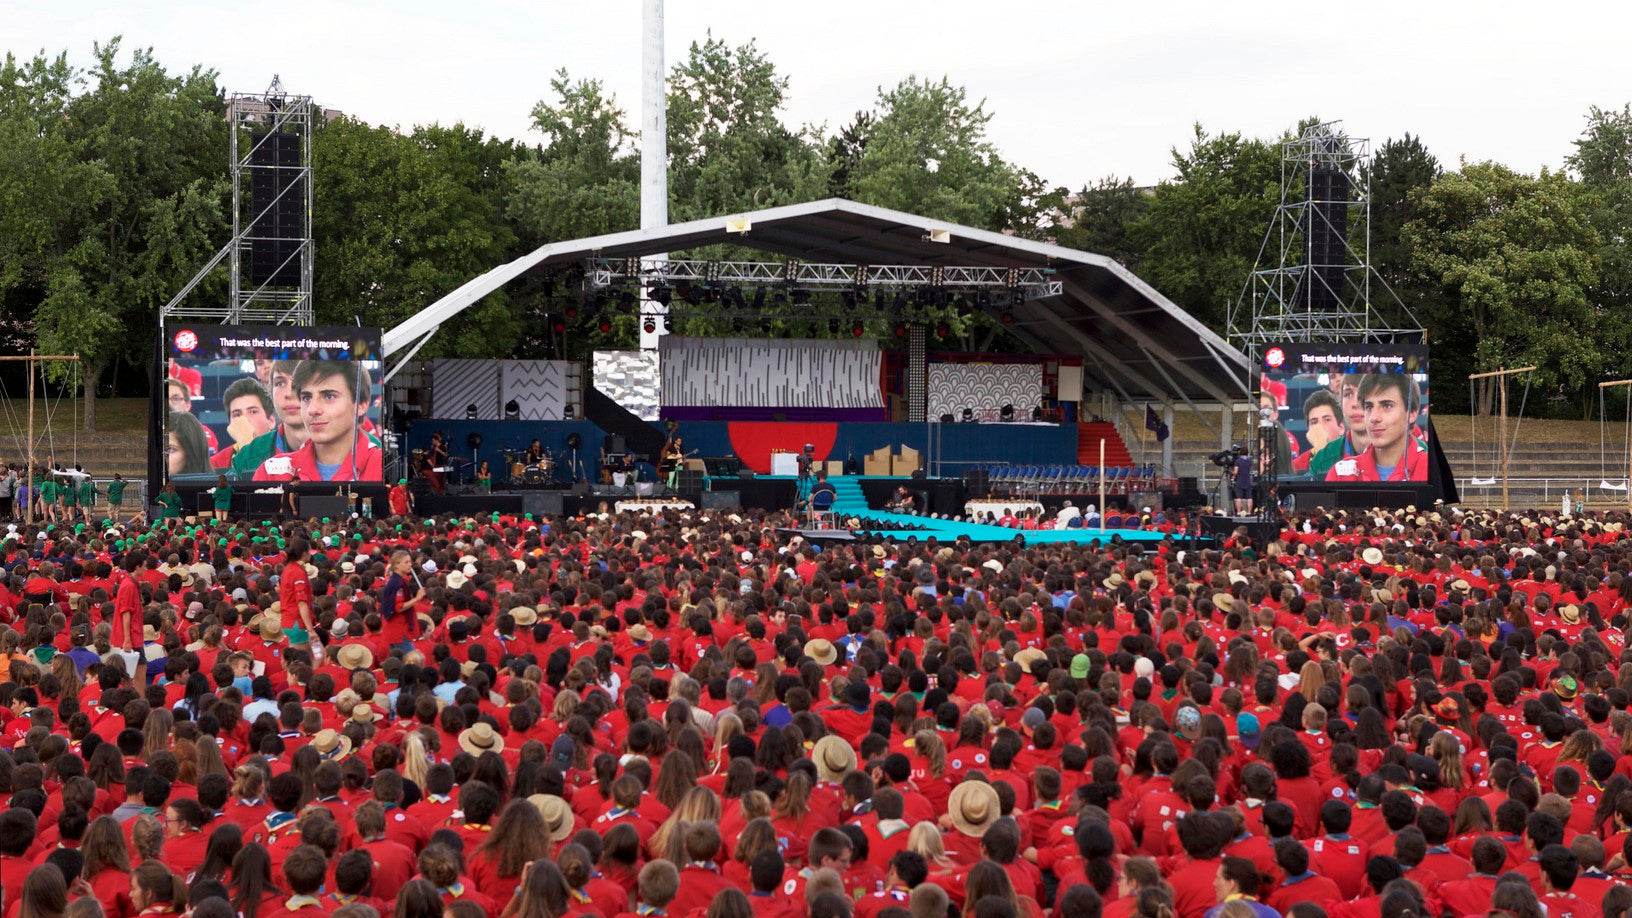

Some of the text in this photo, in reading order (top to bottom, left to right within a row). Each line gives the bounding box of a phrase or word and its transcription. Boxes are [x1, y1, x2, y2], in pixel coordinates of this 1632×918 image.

[219, 337, 350, 350] That was the best part of the morning.
[1301, 354, 1314, 362] That
[1327, 354, 1337, 363] the
[1337, 354, 1349, 363] best
[1350, 355, 1362, 364] part
[1362, 355, 1369, 363] of
[1369, 355, 1379, 363] the
[1380, 355, 1404, 365] morning.
